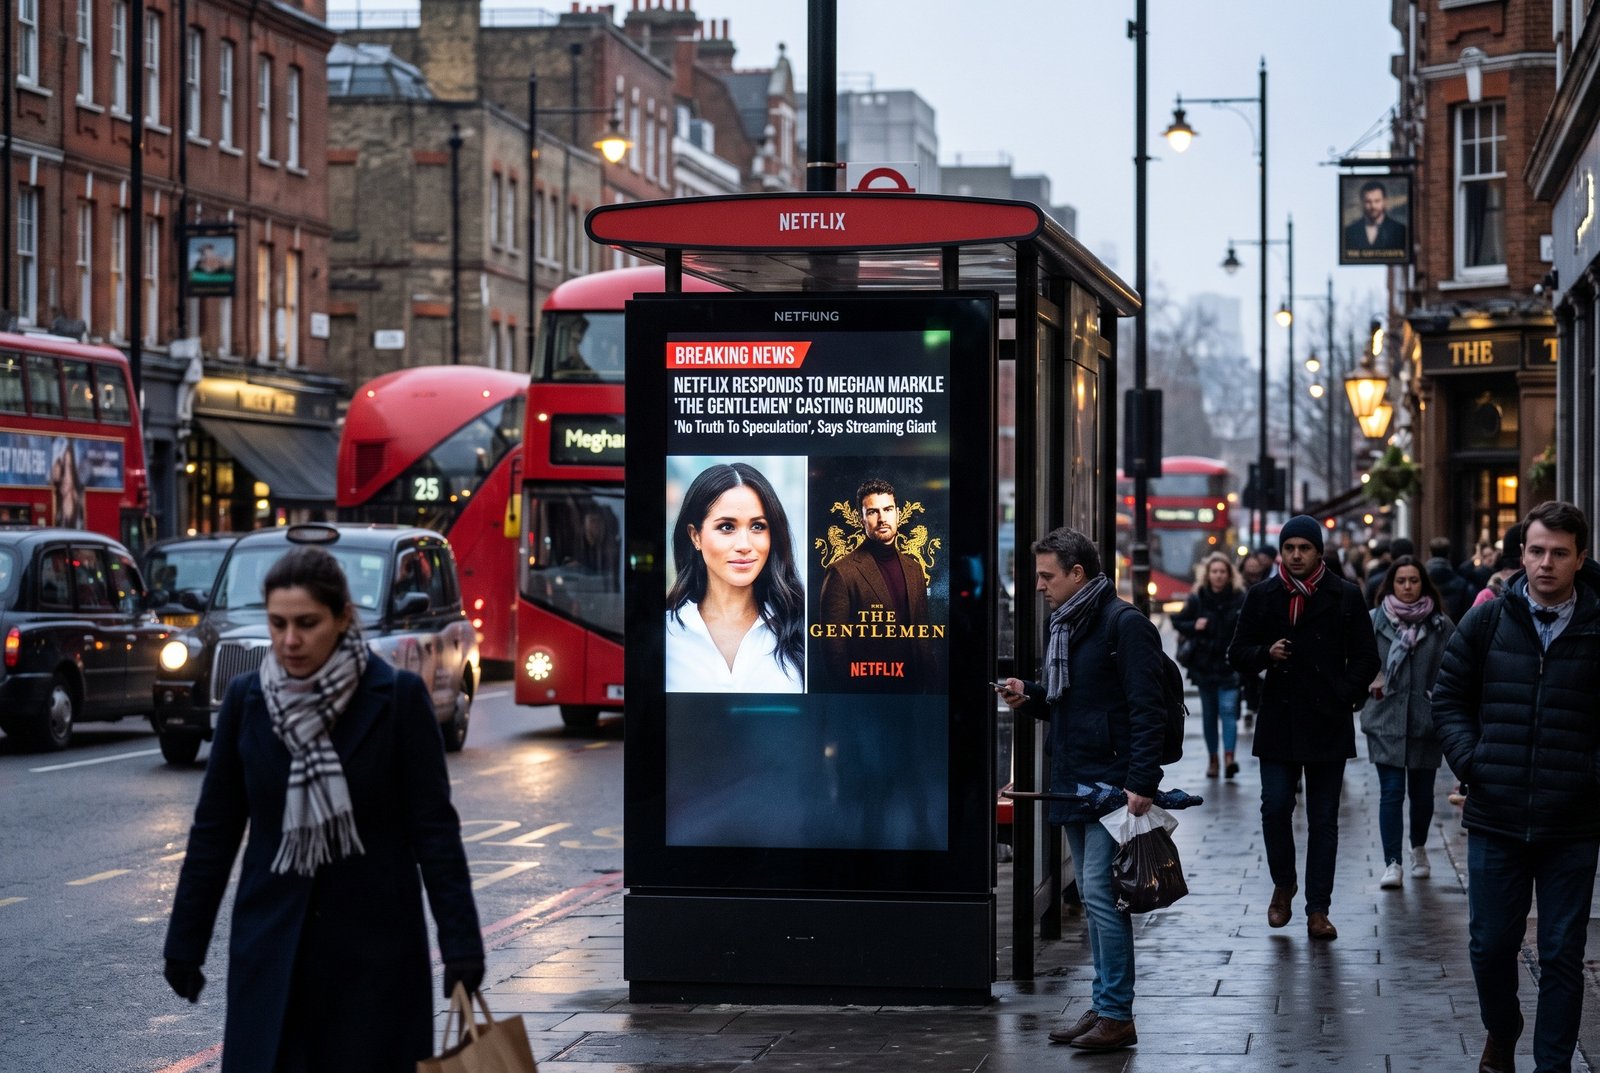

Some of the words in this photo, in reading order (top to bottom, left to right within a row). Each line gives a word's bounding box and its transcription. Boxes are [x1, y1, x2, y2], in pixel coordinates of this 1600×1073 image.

[779, 212, 846, 231] NETFLIX
[675, 346, 749, 365] BREAKING
[752, 346, 795, 365] NEWS
[1448, 340, 1494, 366] THE
[674, 376, 729, 394] NETFLIX
[732, 376, 803, 393] RESPONDS
[806, 376, 824, 393] TO
[827, 376, 885, 393] MEGHAN
[888, 376, 945, 393] MARKLE
[674, 397, 704, 414] 'THE
[707, 397, 793, 414] GENTLEMEN'
[795, 397, 854, 414] CASTING
[856, 397, 923, 414] RUMOURS
[674, 420, 693, 434] 'No
[695, 420, 725, 434] Truth
[727, 420, 740, 434] To
[742, 420, 815, 437] Speculation',
[817, 420, 844, 437] Says
[846, 420, 904, 437] Streaming
[906, 420, 937, 434] Giant
[565, 428, 625, 453] Megha
[414, 477, 440, 501] 25
[858, 611, 896, 622] THE
[809, 624, 946, 638] GENTLEMEN
[850, 662, 905, 678] NETFLIX
